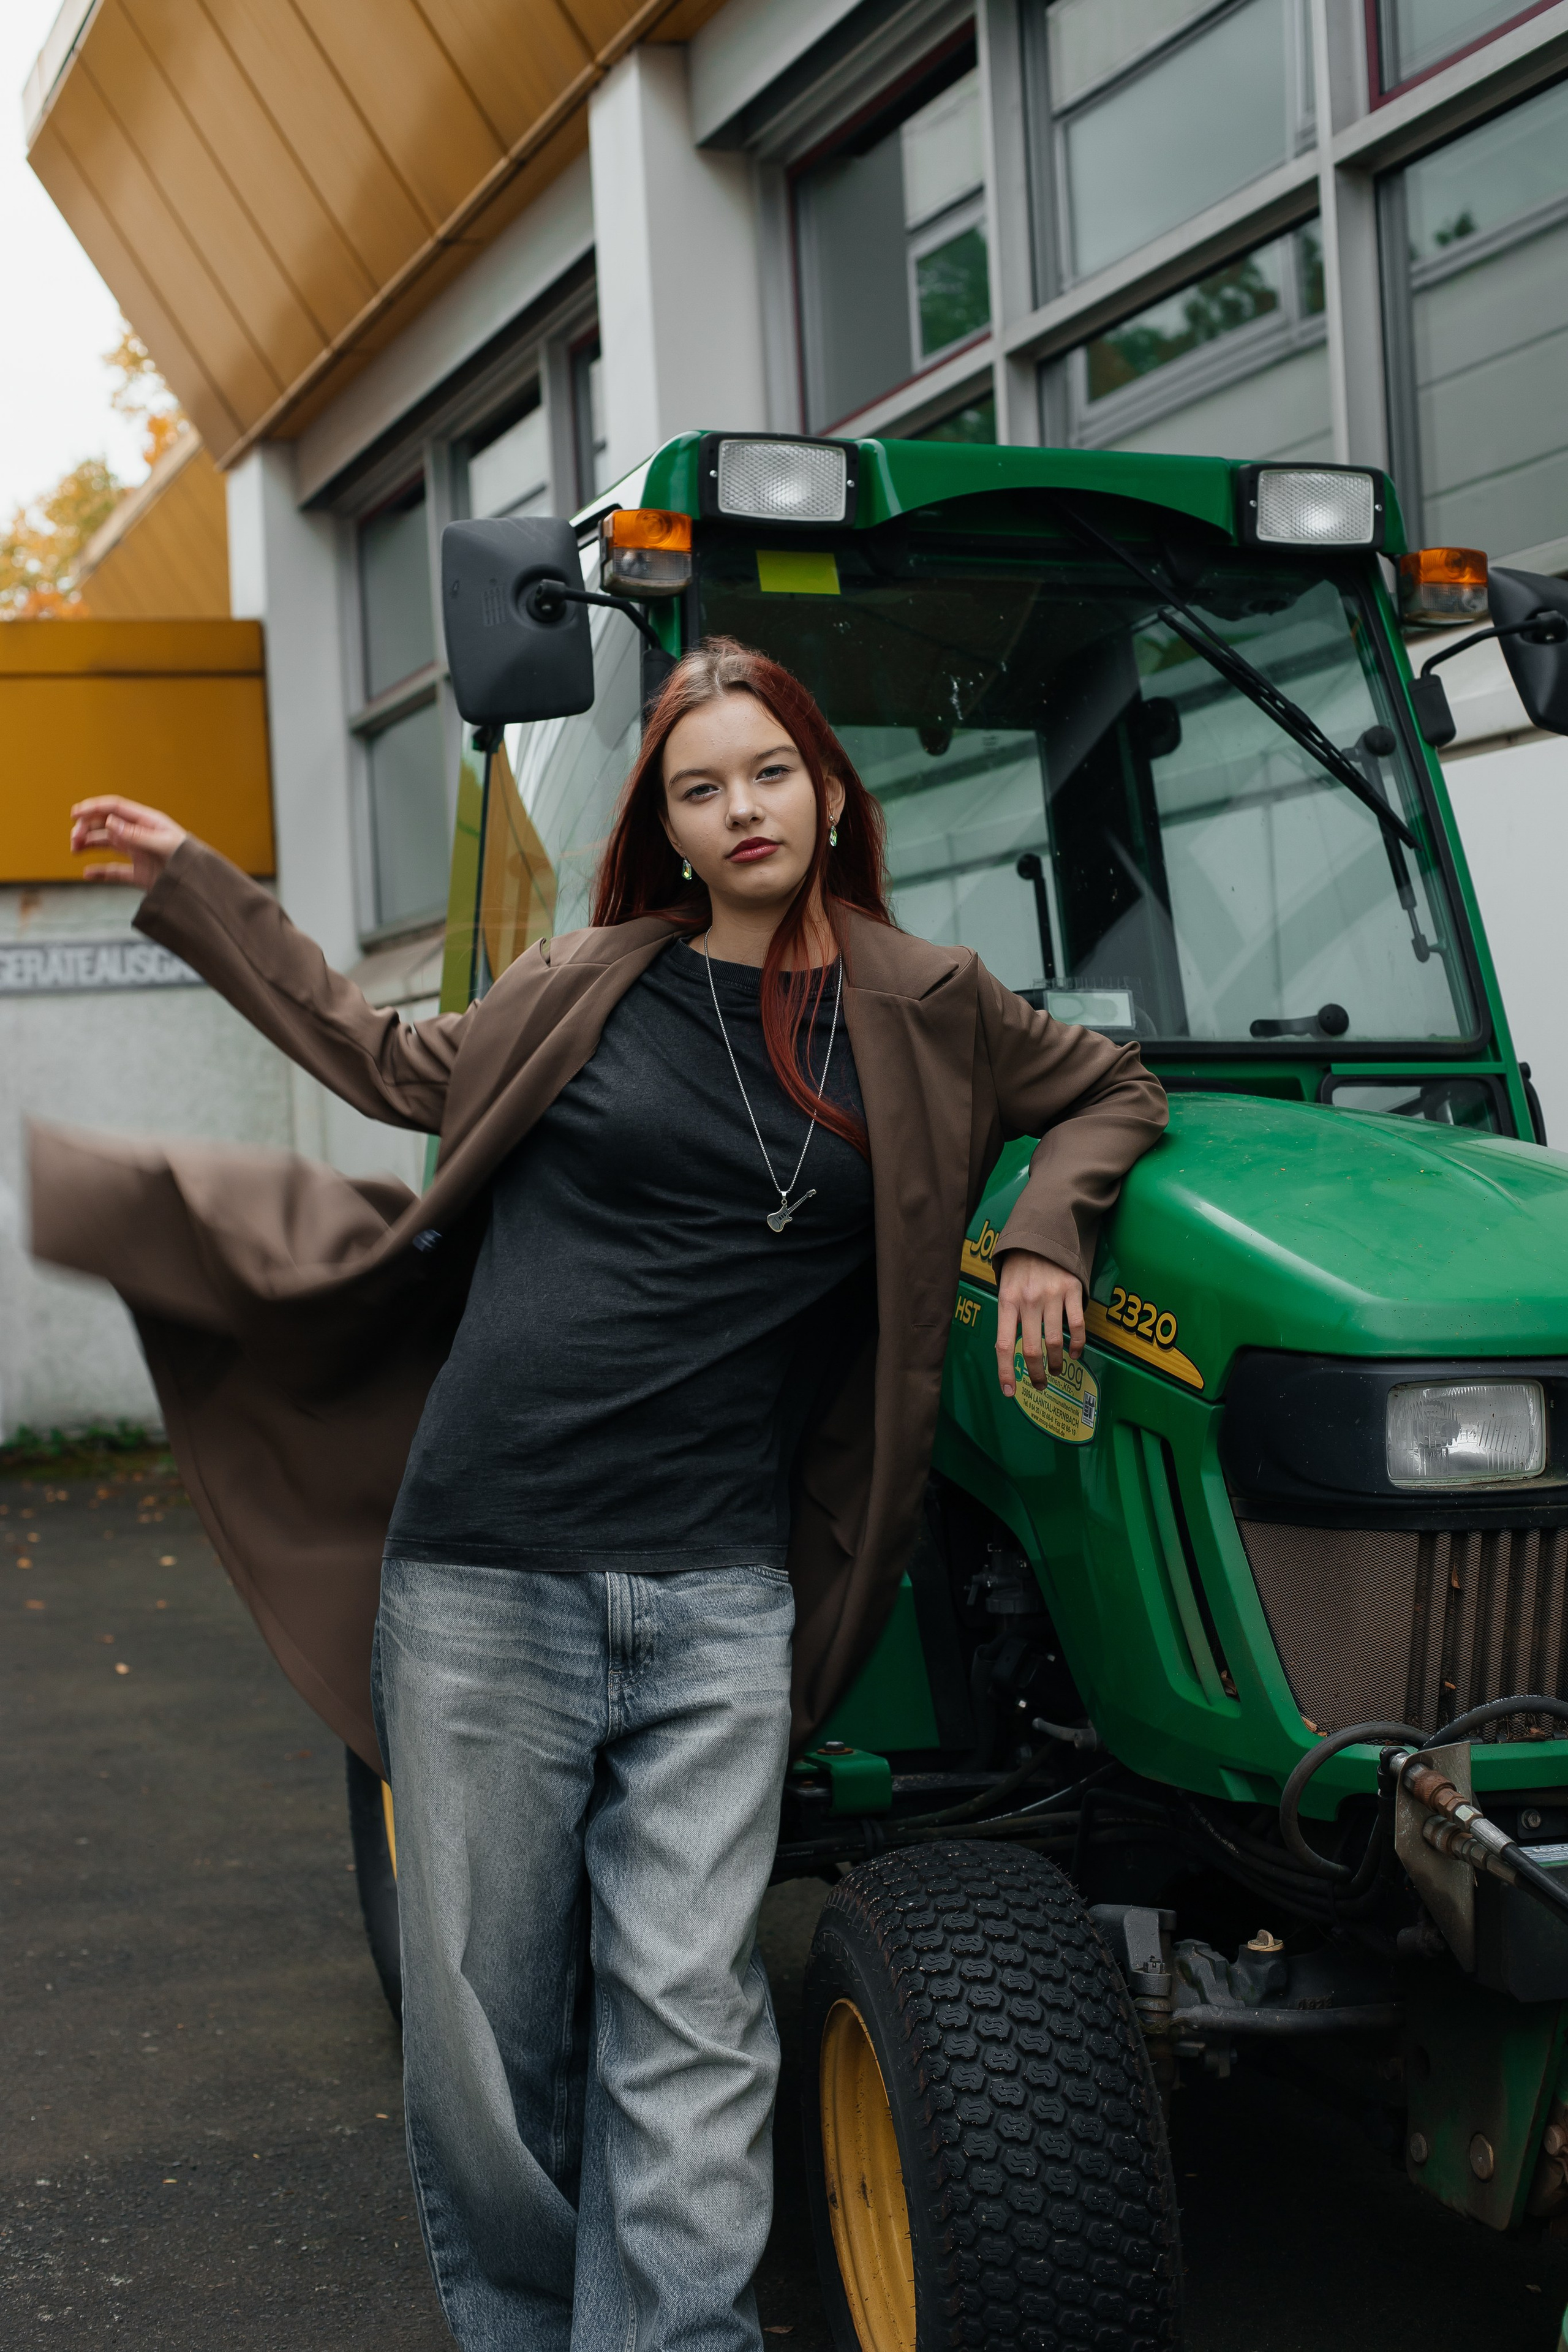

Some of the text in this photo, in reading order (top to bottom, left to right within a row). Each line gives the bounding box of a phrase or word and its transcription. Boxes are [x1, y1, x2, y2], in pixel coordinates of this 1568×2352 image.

[954, 1295, 981, 1327] HST
[1107, 1287, 1177, 1345] 2320
[1022, 1387, 1033, 1400] 35094
[1033, 1394, 1079, 1428] LAHNTAL-KERNBACH
[1044, 1391, 1079, 1417] Kommunaltechnik
[1459, 1427, 1476, 1440] H4
